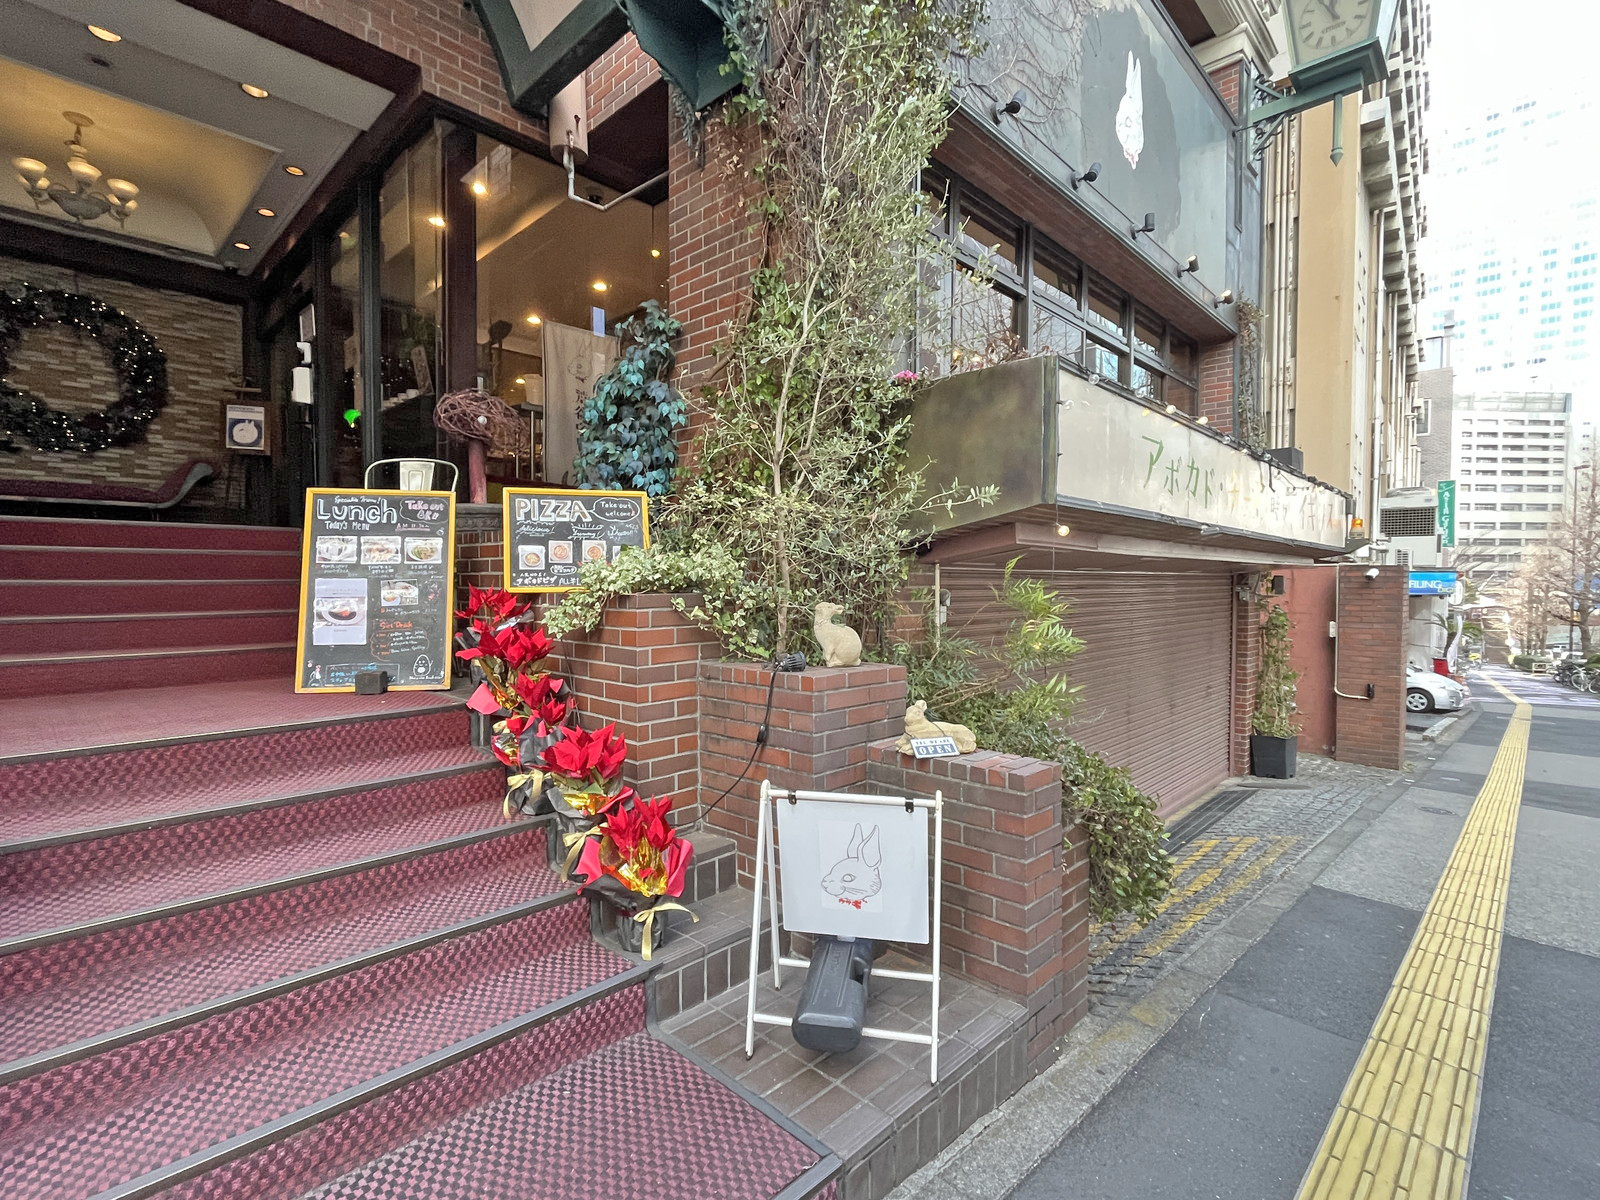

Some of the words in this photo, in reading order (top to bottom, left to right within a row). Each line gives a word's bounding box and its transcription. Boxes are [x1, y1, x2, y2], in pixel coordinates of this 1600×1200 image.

[405, 500, 429, 510] Take
[515, 498, 592, 522] PIZZA
[316, 498, 398, 524] Lunch
[325, 521, 348, 531] Today's
[352, 521, 370, 531] Menu
[918, 744, 952, 755] OPEN
